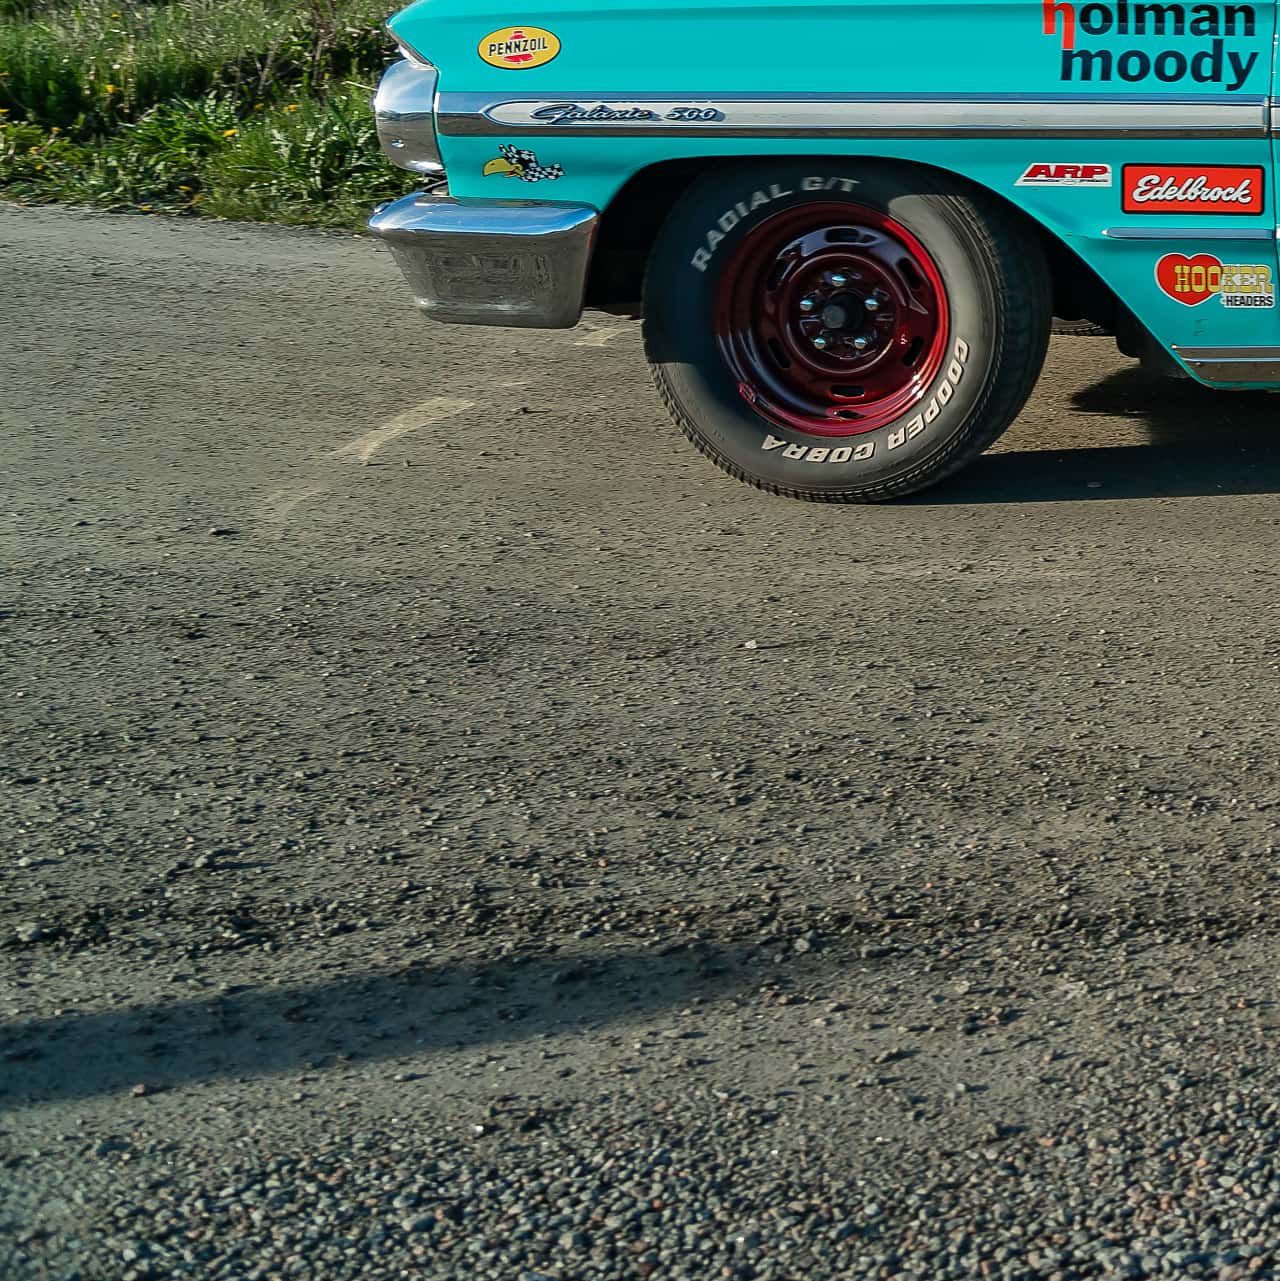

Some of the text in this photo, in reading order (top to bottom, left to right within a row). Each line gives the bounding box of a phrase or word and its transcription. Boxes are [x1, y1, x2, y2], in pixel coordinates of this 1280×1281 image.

[487, 36, 549, 57] PENNZOIL
[1060, 38, 1258, 92] moody
[530, 104, 720, 124] Galaxie 500
[1024, 164, 1109, 179] ARP
[1132, 174, 1252, 204] Edelbrock
[689, 176, 861, 272] RADIAL G/T
[1173, 265, 1273, 294] HOOKER
[1226, 295, 1274, 307] HEADERS
[761, 335, 970, 463] COOPER COBRA
